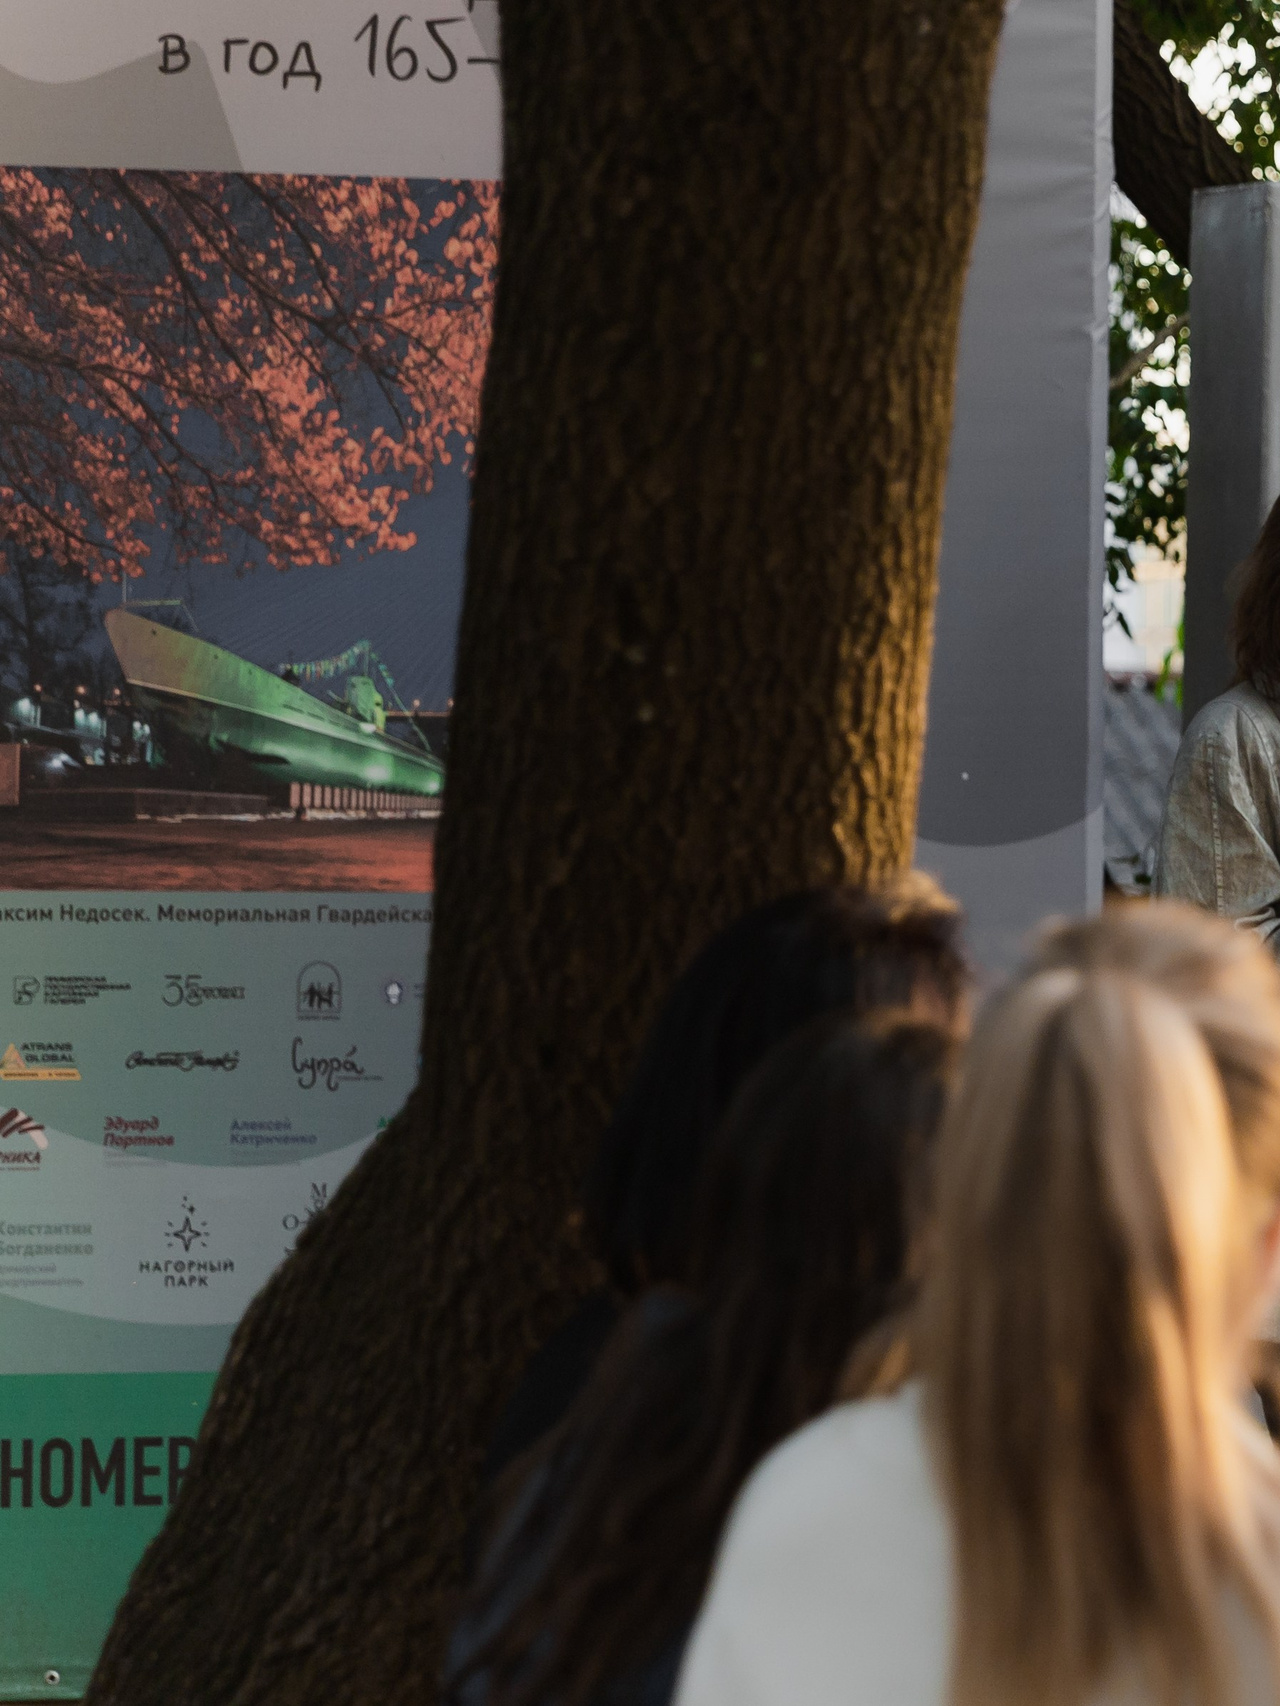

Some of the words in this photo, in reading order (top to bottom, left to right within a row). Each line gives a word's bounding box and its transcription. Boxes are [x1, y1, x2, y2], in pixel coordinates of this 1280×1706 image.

[223, 38, 322, 92] год
[0, 907, 53, 922] ксим
[59, 904, 150, 925] Недосек.
[158, 903, 311, 926] Мемориальная
[316, 903, 433, 926] Гвардейска
[139, 1258, 235, 1273] НАГОРНЫЙ
[164, 1275, 209, 1288] ПАРК
[0, 1436, 199, 1508] HOMEP
